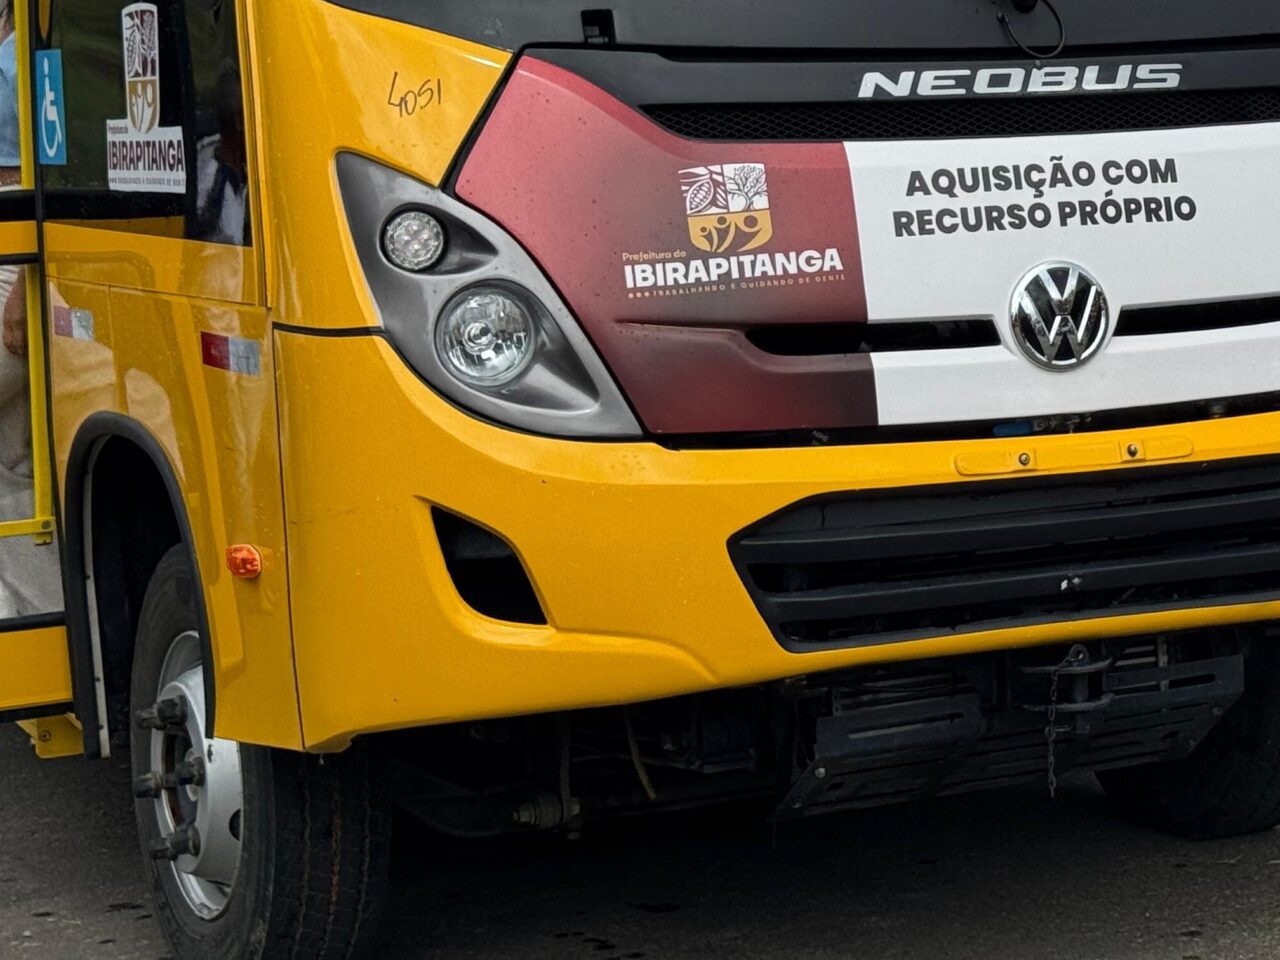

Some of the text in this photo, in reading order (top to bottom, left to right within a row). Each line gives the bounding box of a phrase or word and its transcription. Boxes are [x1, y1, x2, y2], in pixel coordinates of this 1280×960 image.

[388, 71, 442, 119] 4051
[858, 63, 1183, 98] NEOBUS
[108, 140, 185, 172] IBIRAPITANGA
[906, 155, 1179, 199] AQUISIÇÃO COM
[893, 189, 1197, 238] RECURSO PRÓPRIO
[622, 250, 672, 262] Prefeitura
[624, 248, 844, 289] IBIRAPITANGA
